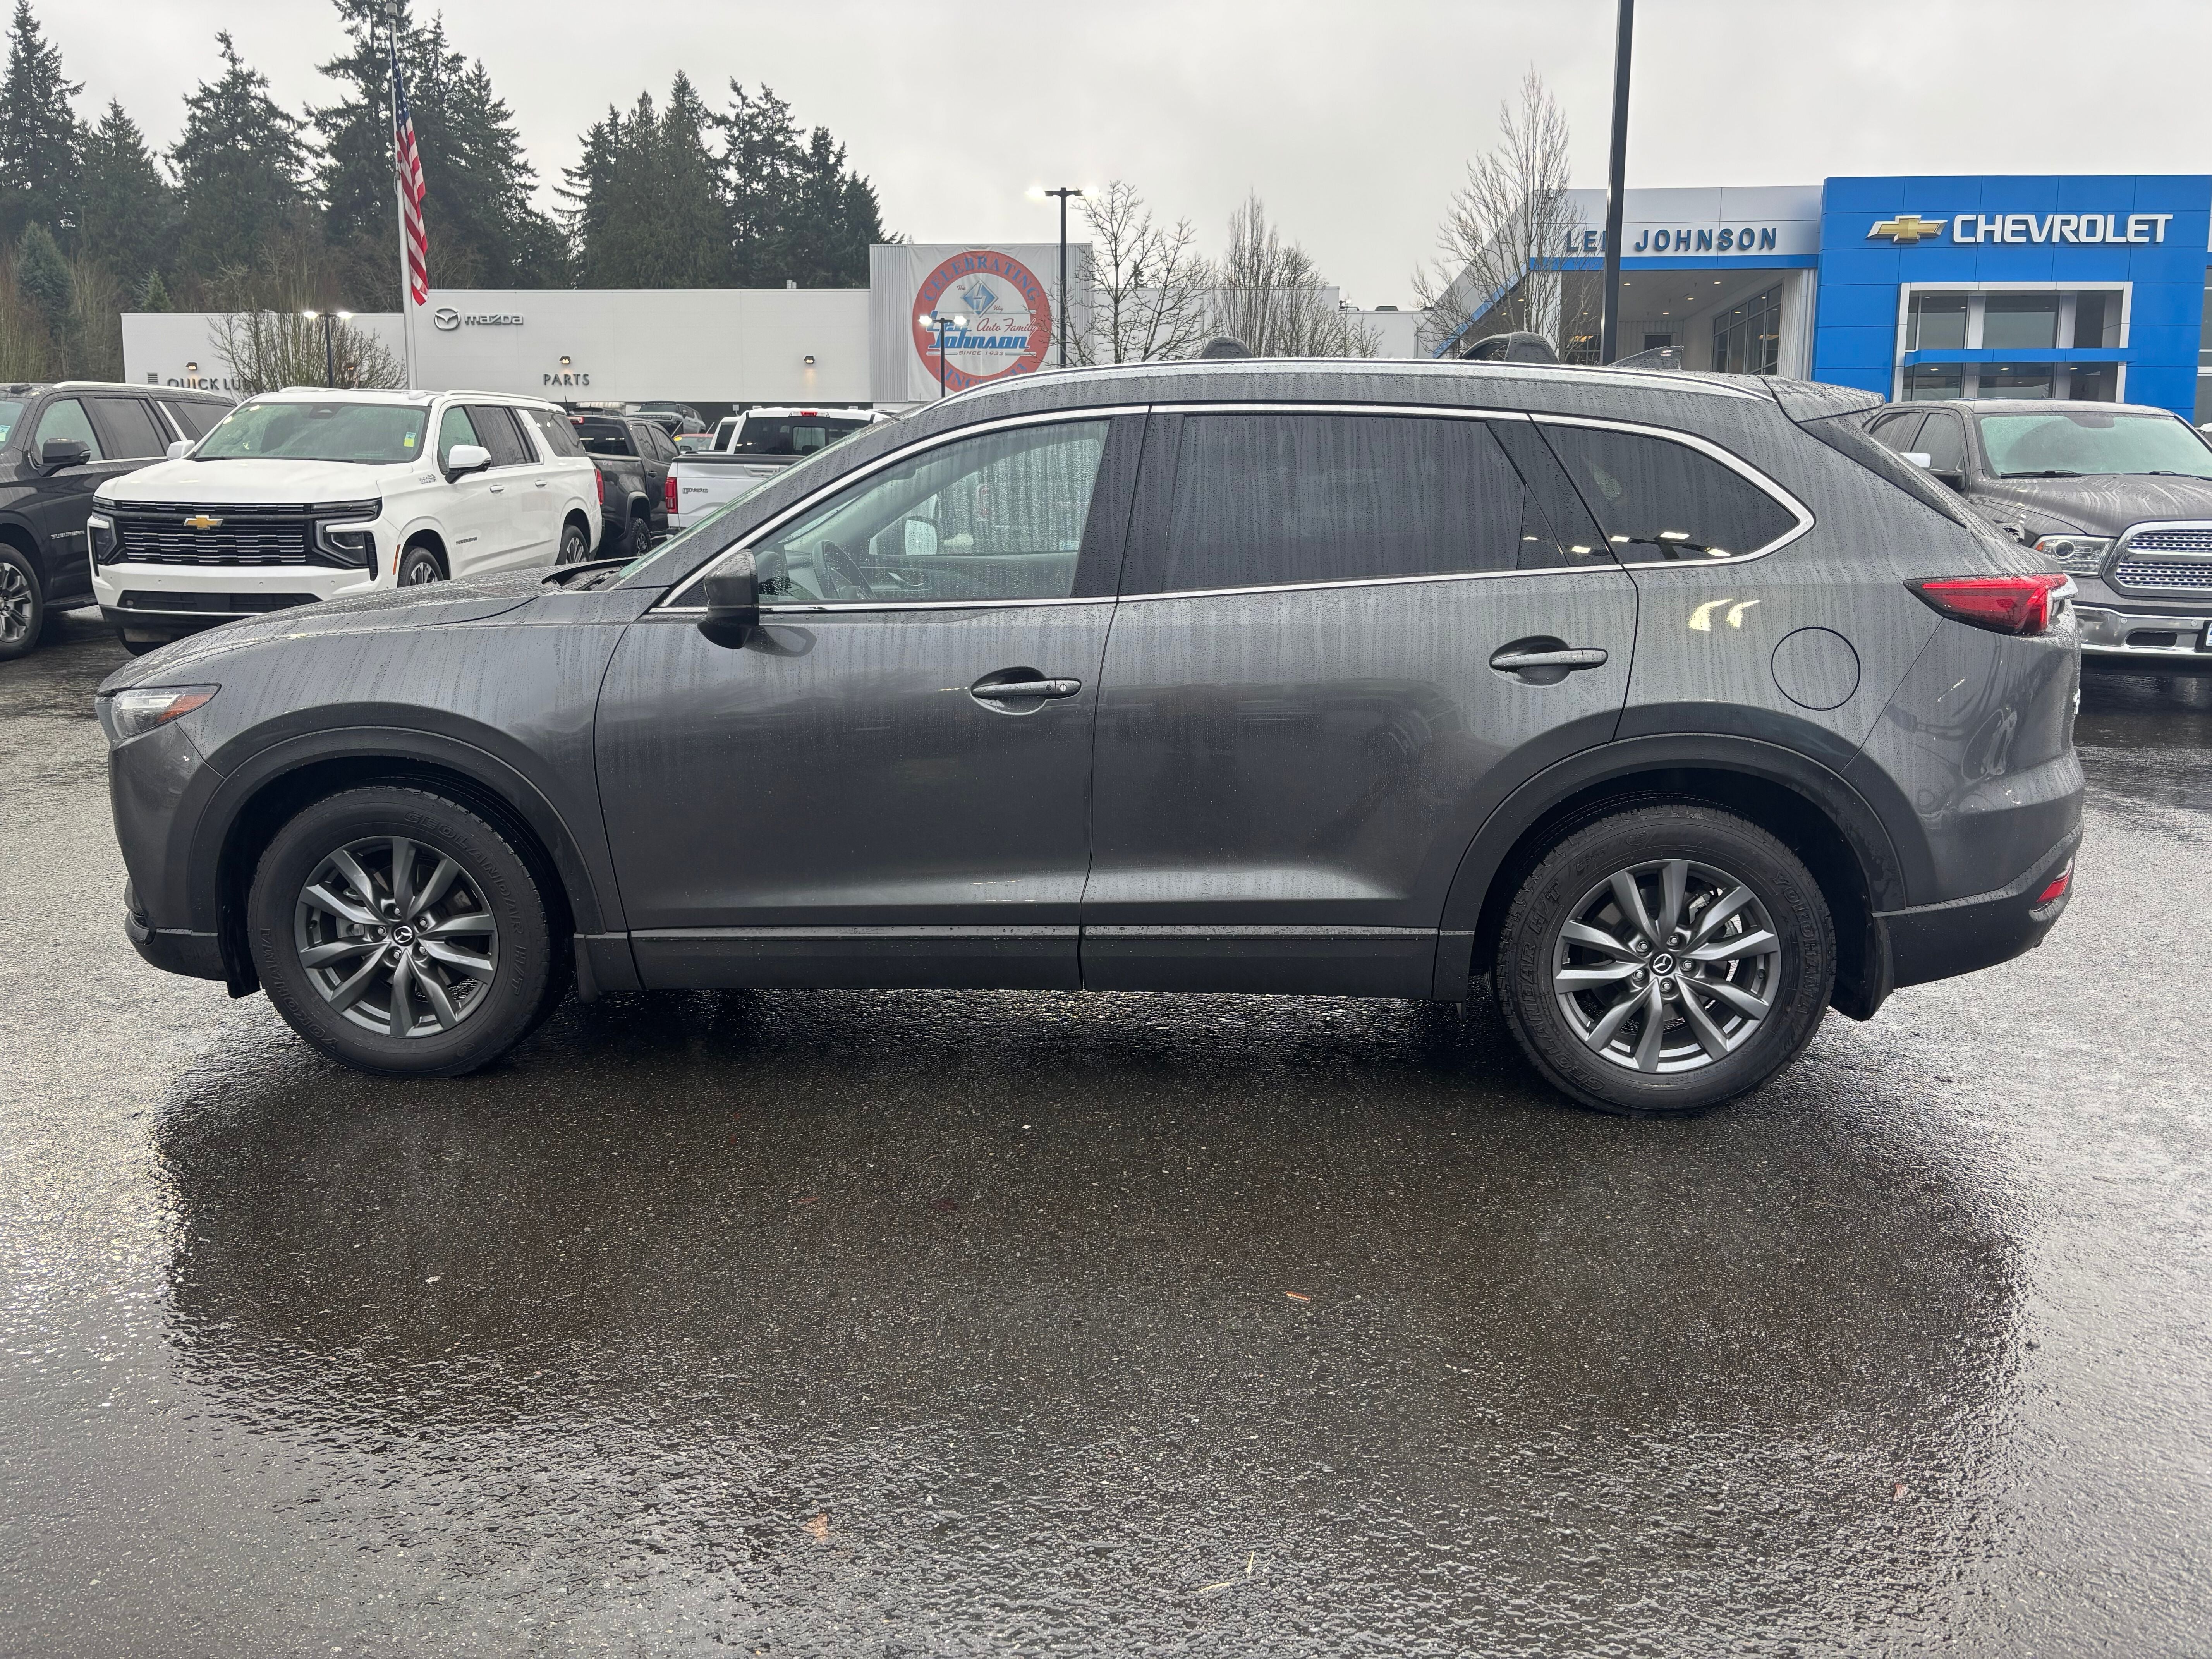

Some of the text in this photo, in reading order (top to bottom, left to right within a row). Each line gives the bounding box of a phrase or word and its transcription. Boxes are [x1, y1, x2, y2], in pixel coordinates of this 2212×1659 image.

[1566, 228, 1777, 252] LE JOHNSON
[1953, 214, 2173, 243] CHEVROLET
[924, 256, 1040, 304] CELEBRATING
[464, 313, 524, 326] mazda
[977, 318, 1038, 337] Auto Family
[167, 378, 220, 390] QUICK
[543, 373, 590, 386] PARTS
[404, 811, 524, 934] GEOLANDAR
[1772, 870, 1819, 1014] YOKOHAMA
[259, 928, 339, 1051] YOKOHAMA
[1520, 942, 1606, 1091] GEOLANDAR
